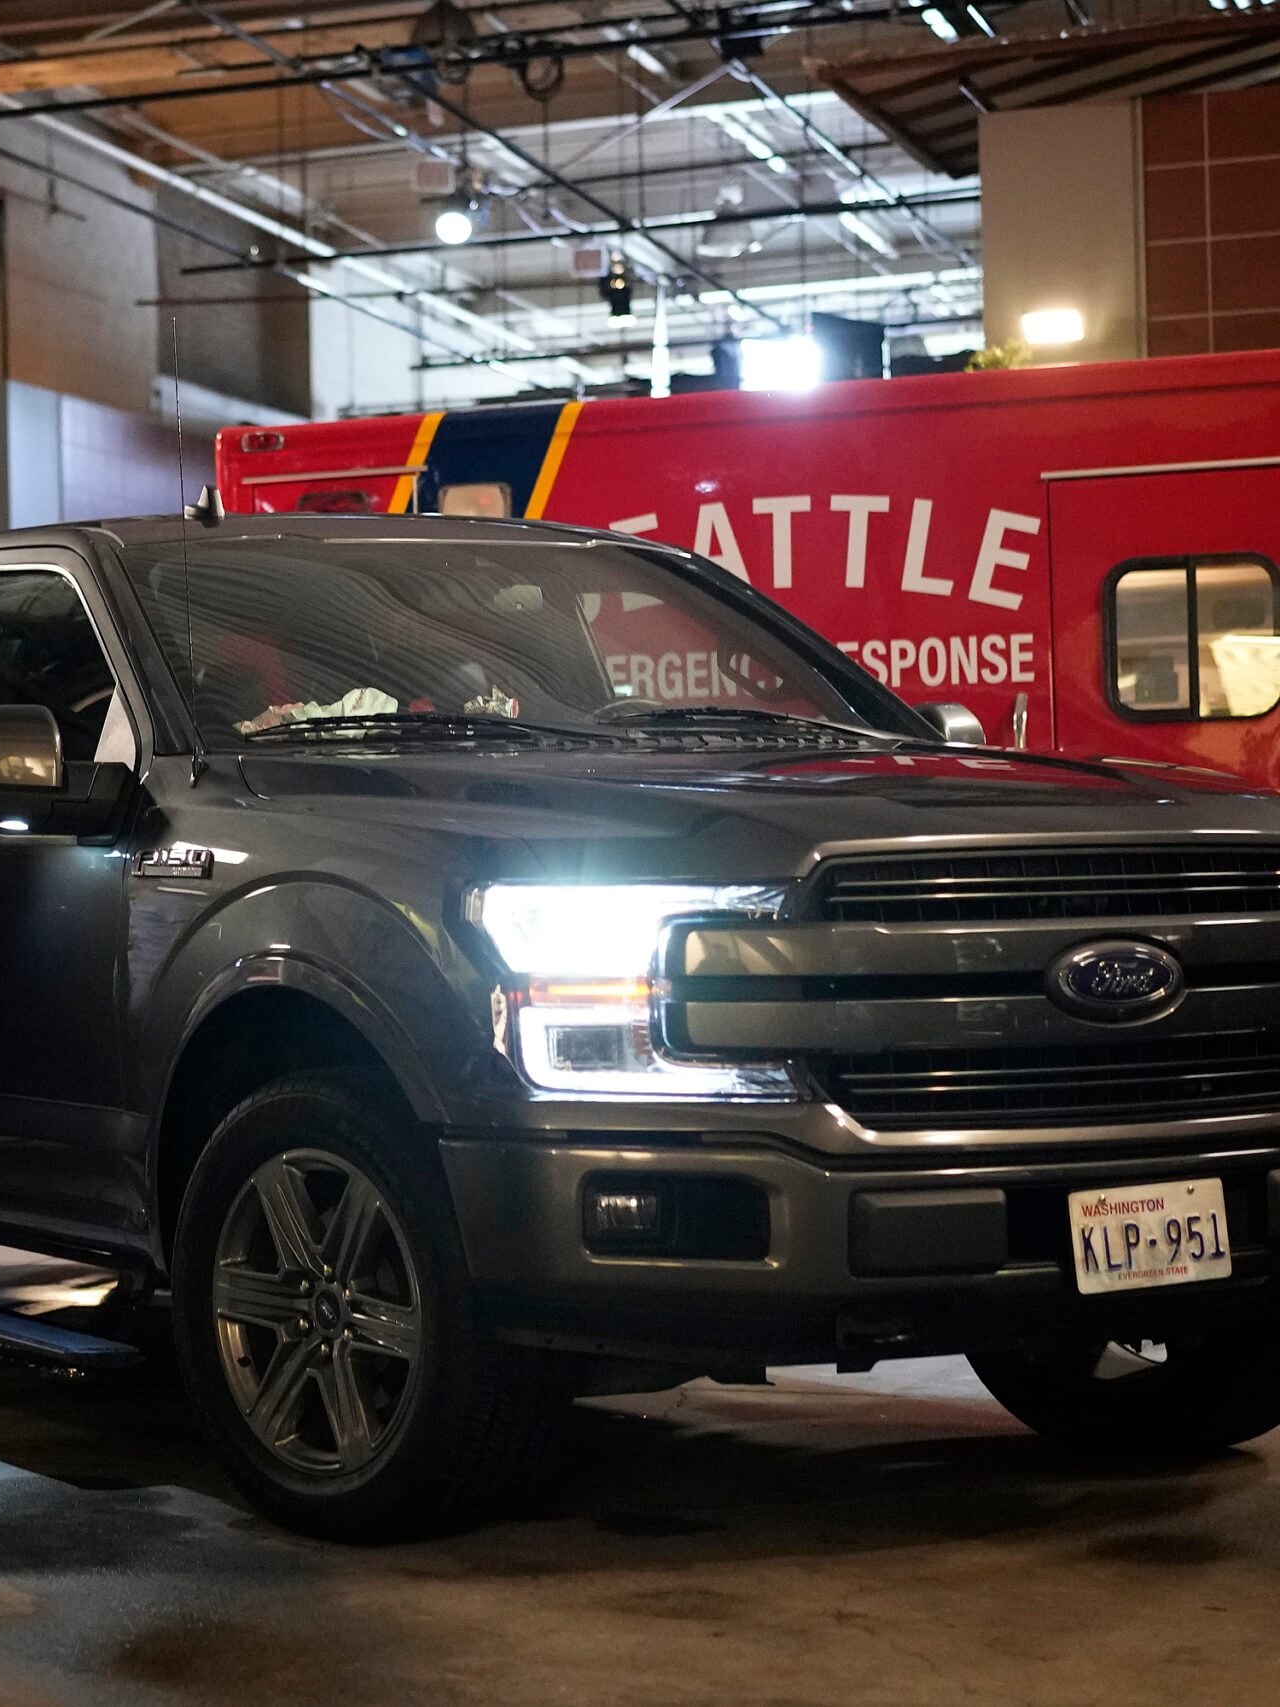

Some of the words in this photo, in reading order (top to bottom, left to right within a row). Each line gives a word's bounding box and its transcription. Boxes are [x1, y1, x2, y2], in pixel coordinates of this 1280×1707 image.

[1081, 1198, 1165, 1218] WASHINGTON
[1118, 1268, 1164, 1281] EVERGREEN
[1165, 1264, 1189, 1276] STATE
